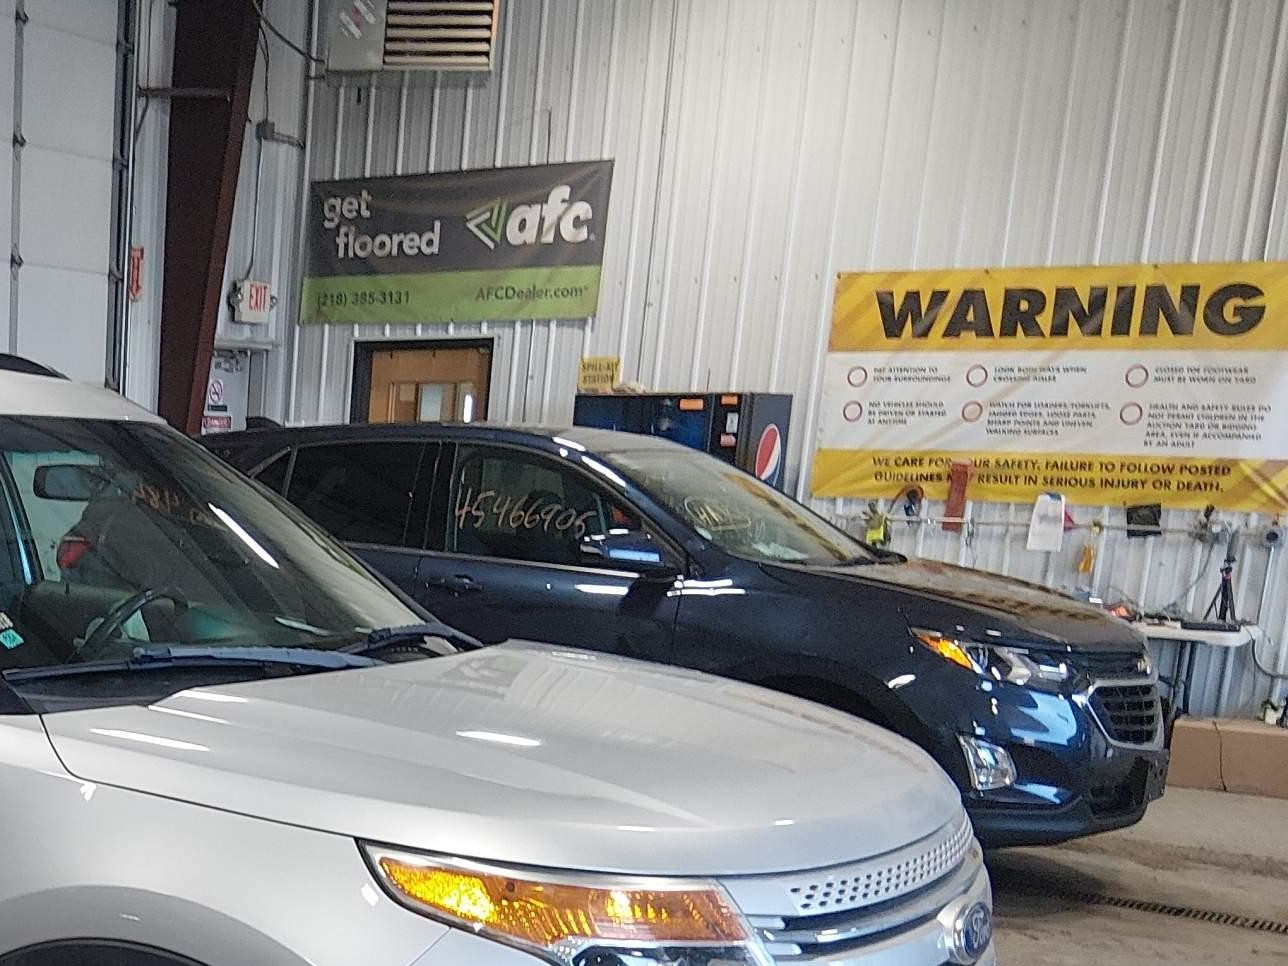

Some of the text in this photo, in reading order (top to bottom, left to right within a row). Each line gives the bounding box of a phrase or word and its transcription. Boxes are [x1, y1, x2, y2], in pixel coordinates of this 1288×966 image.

[323, 190, 372, 229] get
[505, 184, 592, 246] afc
[336, 220, 441, 259] floored
[248, 283, 268, 312] EXIT
[317, 291, 348, 311] (218)
[476, 283, 584, 302] AFCDealer.com
[875, 281, 1267, 339] WARNING
[872, 456, 892, 468] WE
[894, 456, 925, 468] CARE
[928, 457, 953, 468] FOR
[994, 458, 1042, 471] SAFETY,
[1045, 460, 1094, 472] FAILURE
[1099, 461, 1116, 474] TO
[1120, 462, 1176, 475] FOLLOW
[1179, 463, 1232, 477] POSTED
[874, 471, 943, 483] GUIDELINES
[977, 473, 1020, 485] RESULT
[1023, 474, 1038, 486] IN
[1041, 475, 1096, 489] SERIOUS
[1099, 477, 1147, 490] INJURY
[1151, 479, 1172, 490] OR
[1176, 480, 1225, 493] DEATH.
[455, 484, 597, 539] 45466905
